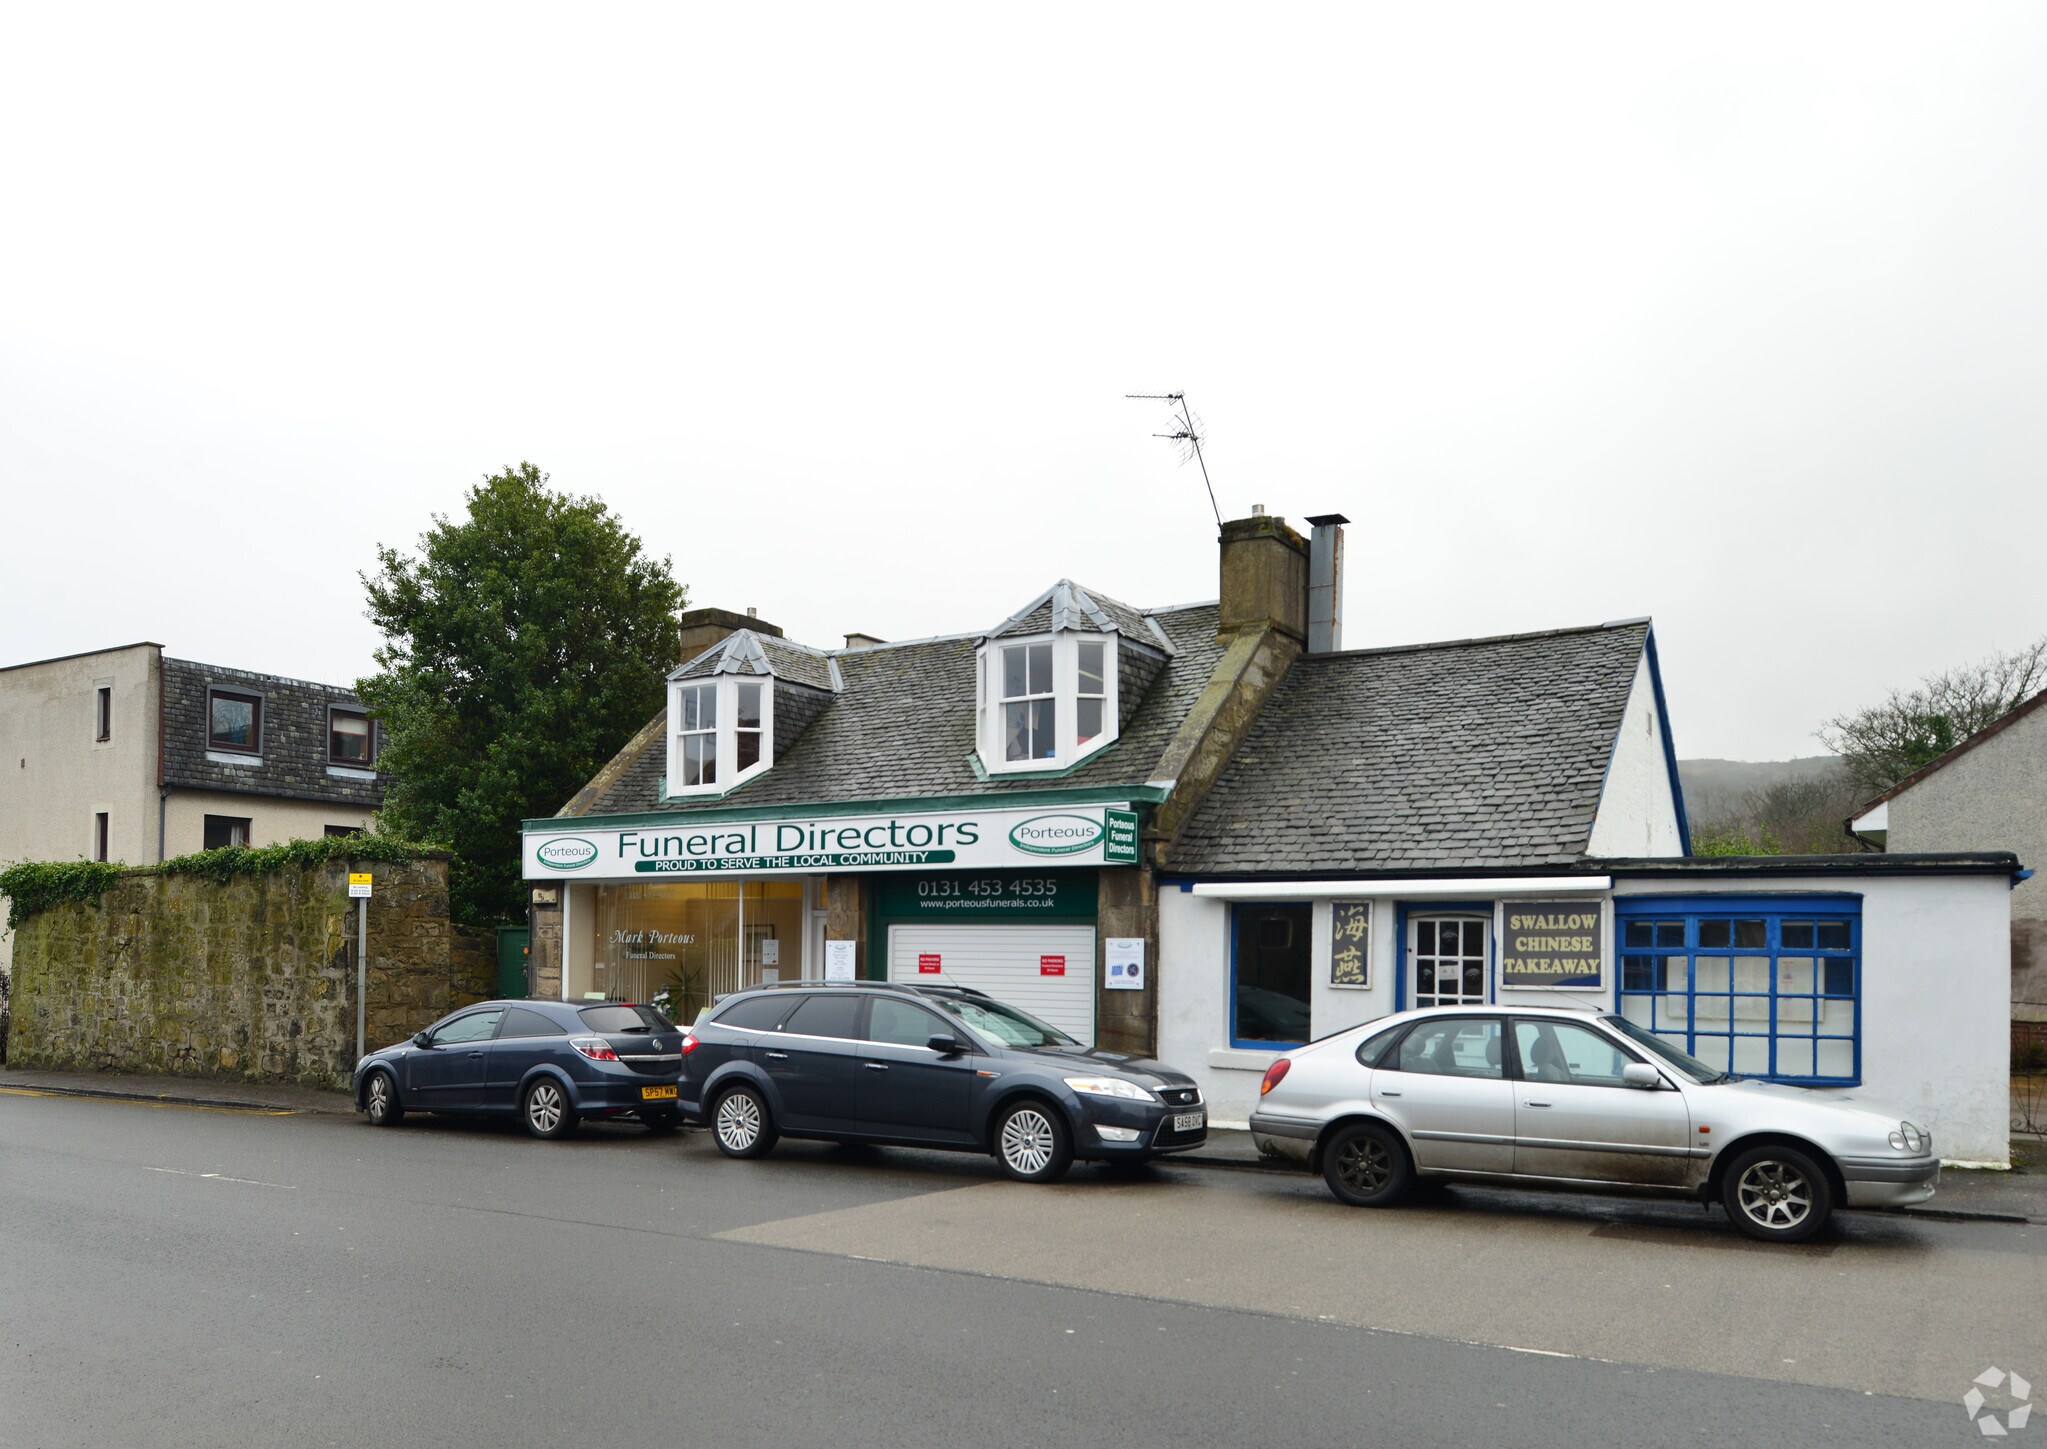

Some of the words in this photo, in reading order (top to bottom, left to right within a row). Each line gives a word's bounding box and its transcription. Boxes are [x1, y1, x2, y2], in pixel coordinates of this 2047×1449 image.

[1109, 817, 1135, 830] Porteous
[619, 825, 756, 858] Funeral
[776, 820, 979, 852] Directors
[1021, 827, 1095, 839] Porteous
[1111, 830, 1133, 842] Funeral
[544, 847, 591, 857] Porteous
[1108, 842, 1135, 855] Directors
[655, 860, 697, 871] PROUD
[700, 859, 717, 870] TO
[720, 858, 760, 869] SERVE
[763, 856, 789, 868] THE
[794, 854, 836, 867] LOCAL
[840, 851, 929, 865] COMMUNITY
[918, 881, 961, 896] 0131
[968, 880, 1002, 896] 453
[1009, 879, 1057, 896] 4535
[920, 898, 1054, 909] www.porteousfunerals.co.uk
[1510, 914, 1598, 930] SWALLOW
[609, 929, 644, 944] Mark
[648, 929, 695, 944] Porteous
[1333, 905, 1368, 983] 海燕
[1515, 936, 1593, 952] CHINESE
[625, 951, 647, 959] Funeral
[648, 951, 676, 959] Directors
[1503, 958, 1600, 974] TAKEAWAY
[645, 1087, 663, 1097] SP57
